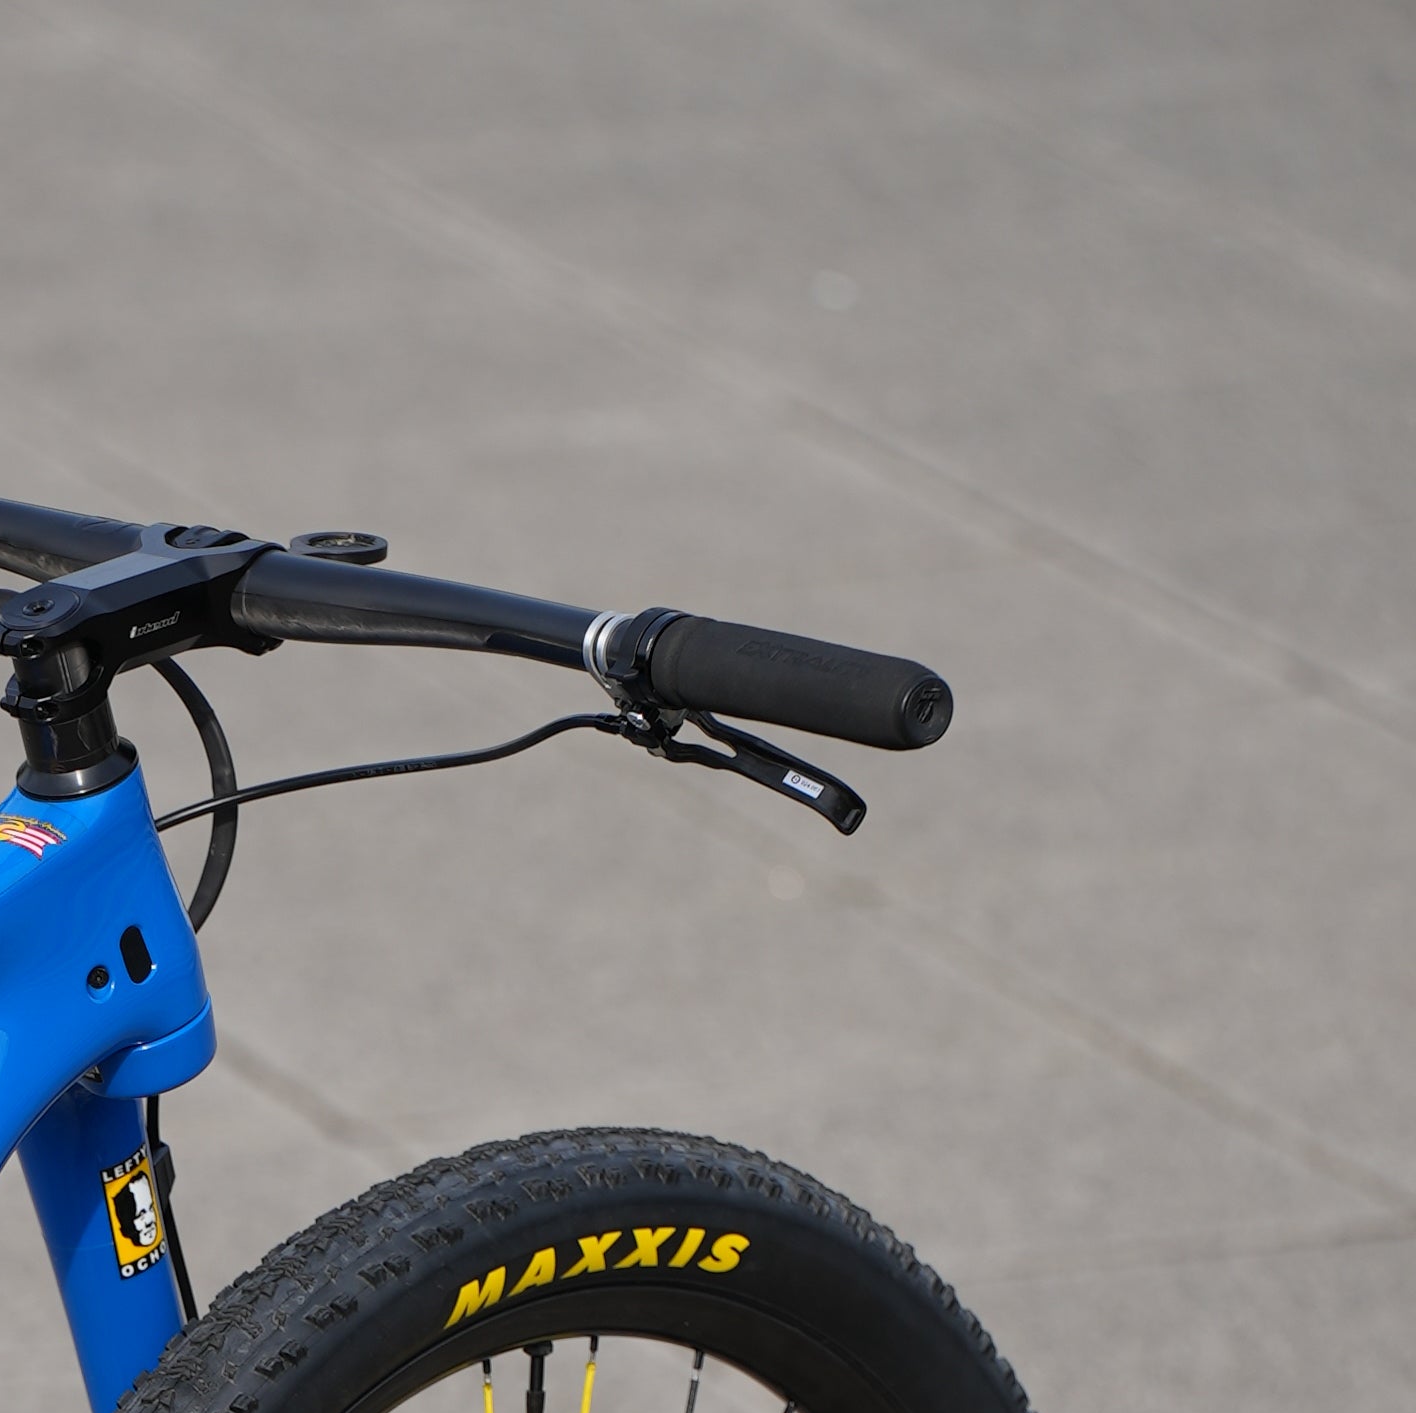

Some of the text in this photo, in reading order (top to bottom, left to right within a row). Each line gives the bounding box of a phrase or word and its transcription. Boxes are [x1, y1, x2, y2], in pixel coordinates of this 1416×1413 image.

[101, 1143, 149, 1184] LEFTY
[120, 1240, 168, 1279] OCHO
[444, 1226, 751, 1330] MAXXIS
